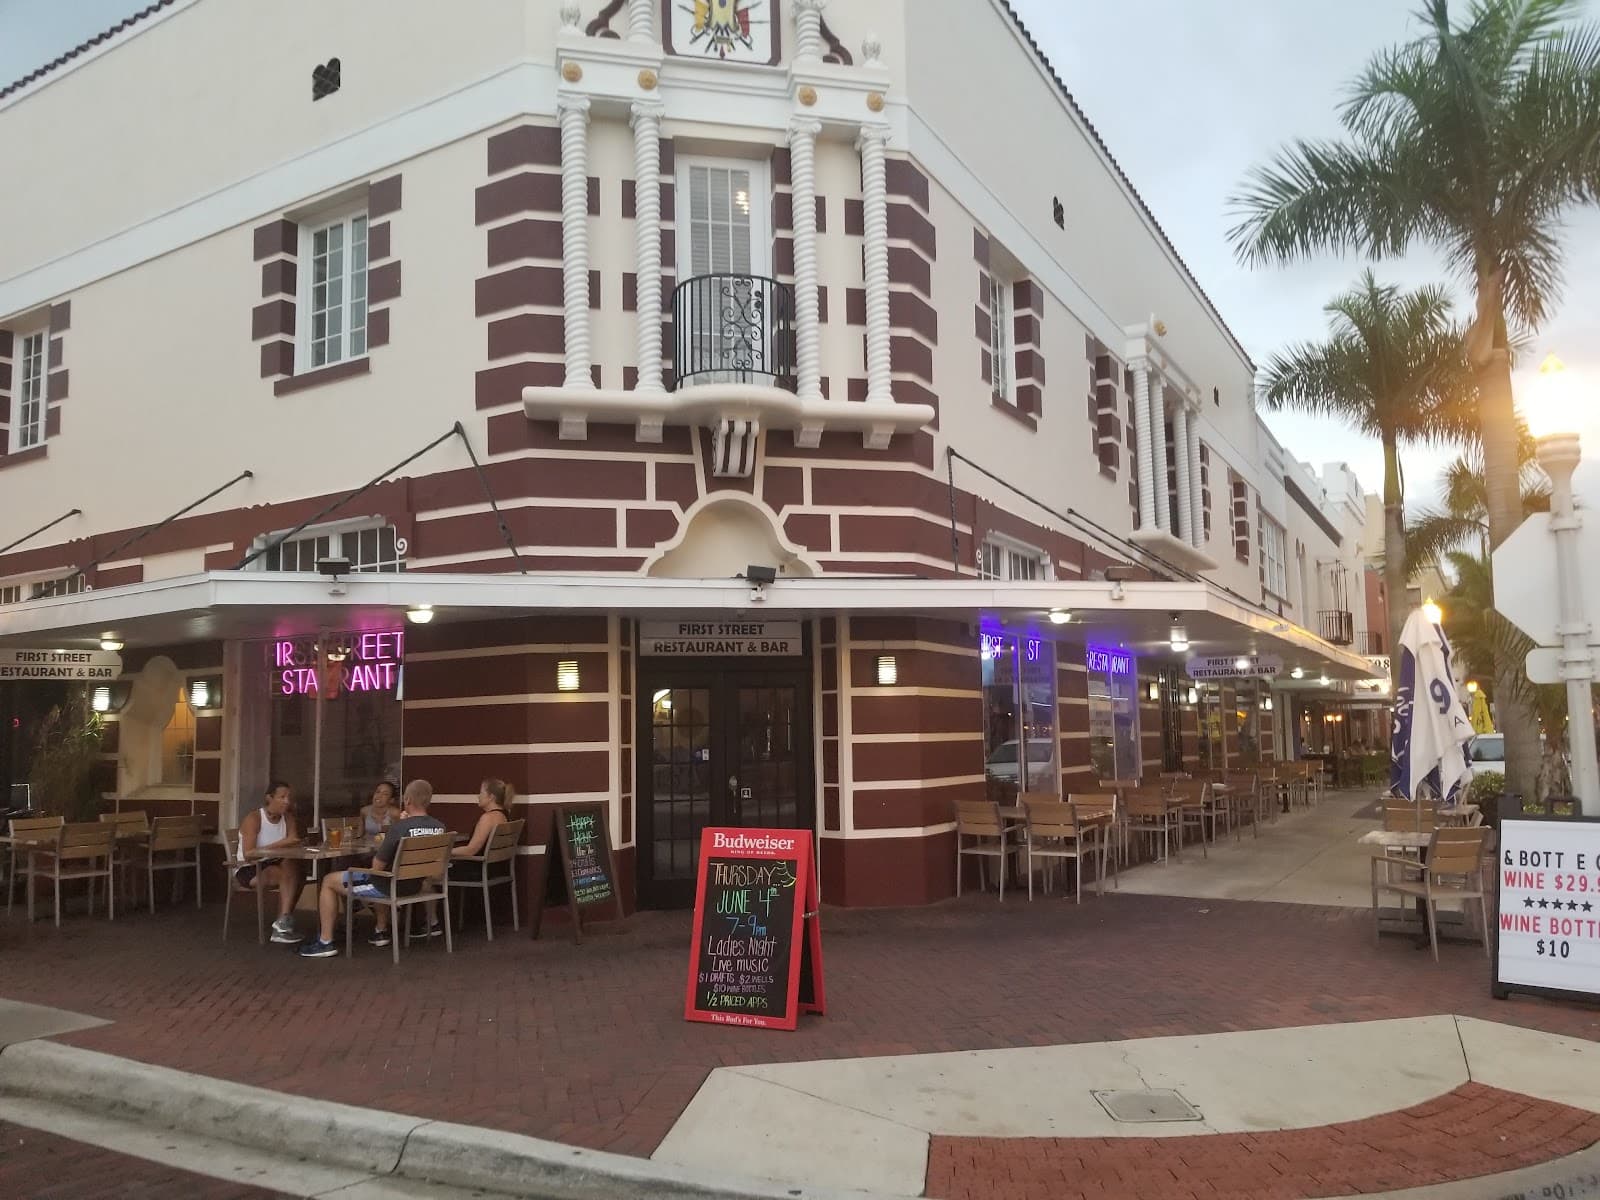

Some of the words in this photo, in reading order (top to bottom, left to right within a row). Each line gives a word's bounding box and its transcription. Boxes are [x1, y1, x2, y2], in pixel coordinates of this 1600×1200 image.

[679, 624, 714, 635] FIRST
[718, 624, 764, 635] STREET
[654, 641, 744, 653] RESTAURANT
[748, 642, 757, 653] &
[761, 641, 788, 653] BAR
[1028, 639, 1040, 661] ST
[15, 652, 48, 662] FIRST
[51, 652, 92, 663] STREET
[0, 666, 73, 677] ESTAURANT
[76, 667, 85, 677] &
[88, 668, 112, 677] BAR
[1257, 667, 1276, 675] BAR
[713, 833, 794, 850] Budweiser
[1504, 850, 1513, 866] &
[1504, 871, 1545, 889] WINE
[716, 889, 752, 914] JUNE
[1501, 913, 1541, 933] WINE
[708, 935, 745, 956] Ladies
[748, 936, 777, 957] Night
[1536, 939, 1570, 959] $10
[710, 972, 735, 983] DRAFTS
[720, 994, 746, 1007] PRICED
[747, 997, 768, 1009] APPS
[711, 1014, 725, 1022] This
